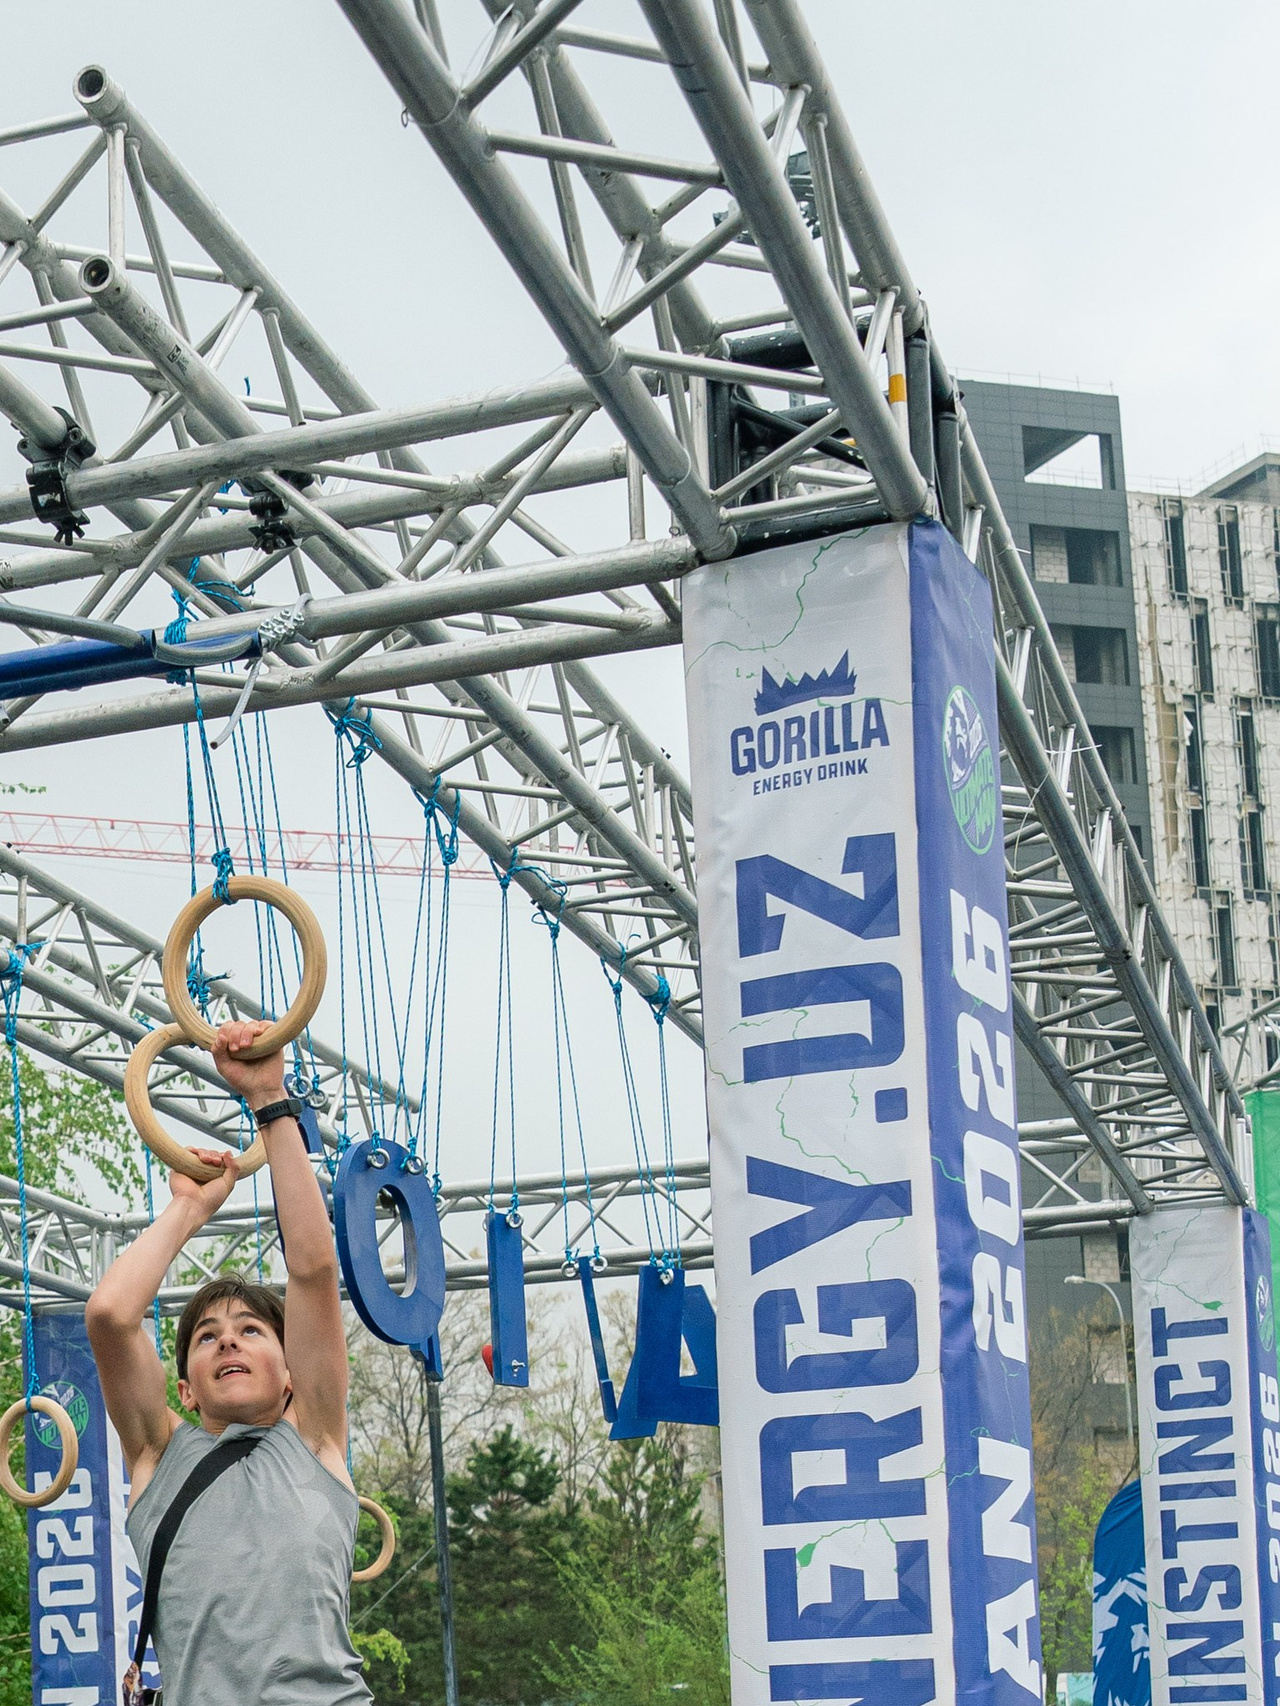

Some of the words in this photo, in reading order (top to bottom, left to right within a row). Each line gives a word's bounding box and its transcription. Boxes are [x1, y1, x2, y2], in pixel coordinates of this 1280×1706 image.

[731, 697, 890, 777] GORILLA
[753, 768, 813, 796] ENERGY
[817, 757, 869, 781] DRINK
[948, 889, 1028, 1364] 2026
[34, 1468, 100, 1655] 2026
[1151, 1306, 1249, 1704] INSTINCT
